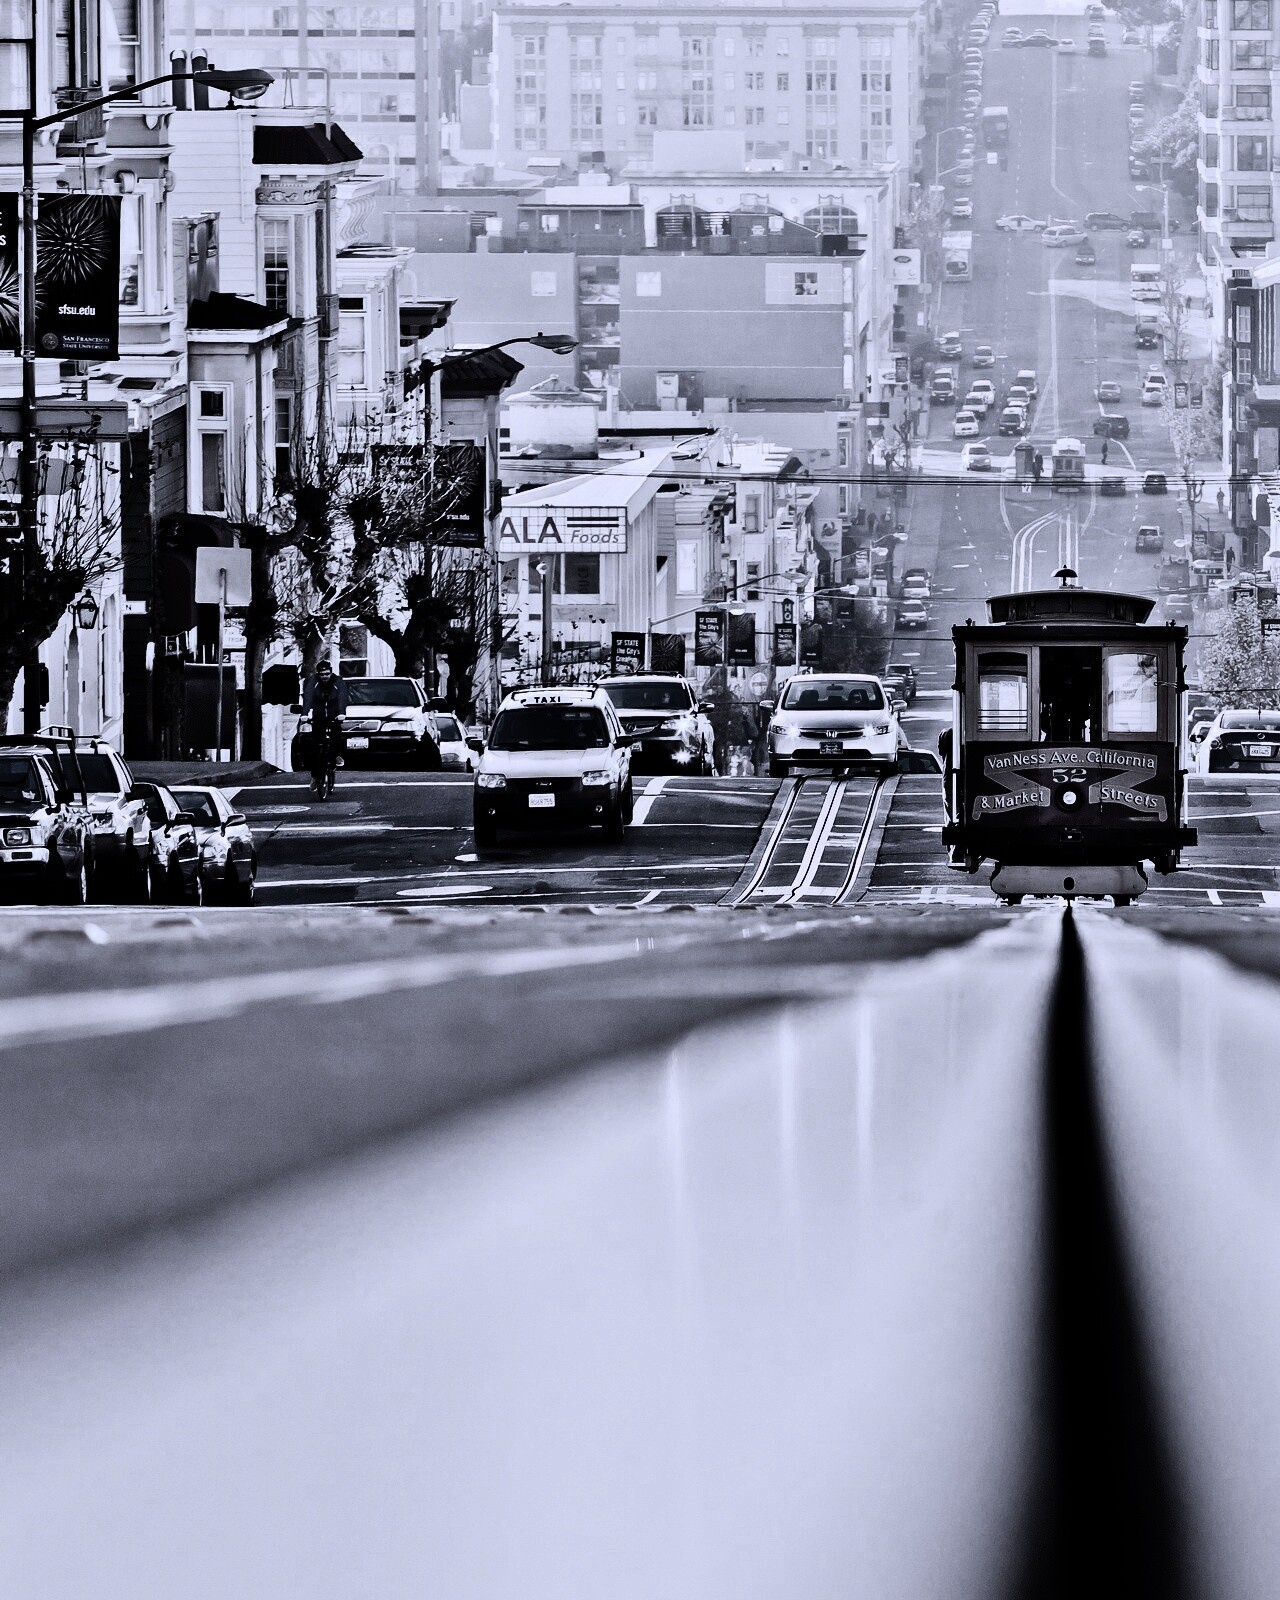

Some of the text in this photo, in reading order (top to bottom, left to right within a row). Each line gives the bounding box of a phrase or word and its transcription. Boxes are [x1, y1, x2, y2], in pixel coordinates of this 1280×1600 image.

[58, 303, 96, 316] sfsu.edu
[500, 516, 563, 544] ALA
[570, 528, 620, 544] Foods
[624, 639, 639, 647] STATE
[222, 654, 229, 663] 2
[533, 696, 561, 704] TAXI
[987, 756, 1012, 769] Van
[1013, 752, 1047, 767] Ness
[1086, 750, 1156, 769] California
[1052, 768, 1088, 784] 52
[981, 787, 1158, 810] & Market Streets
